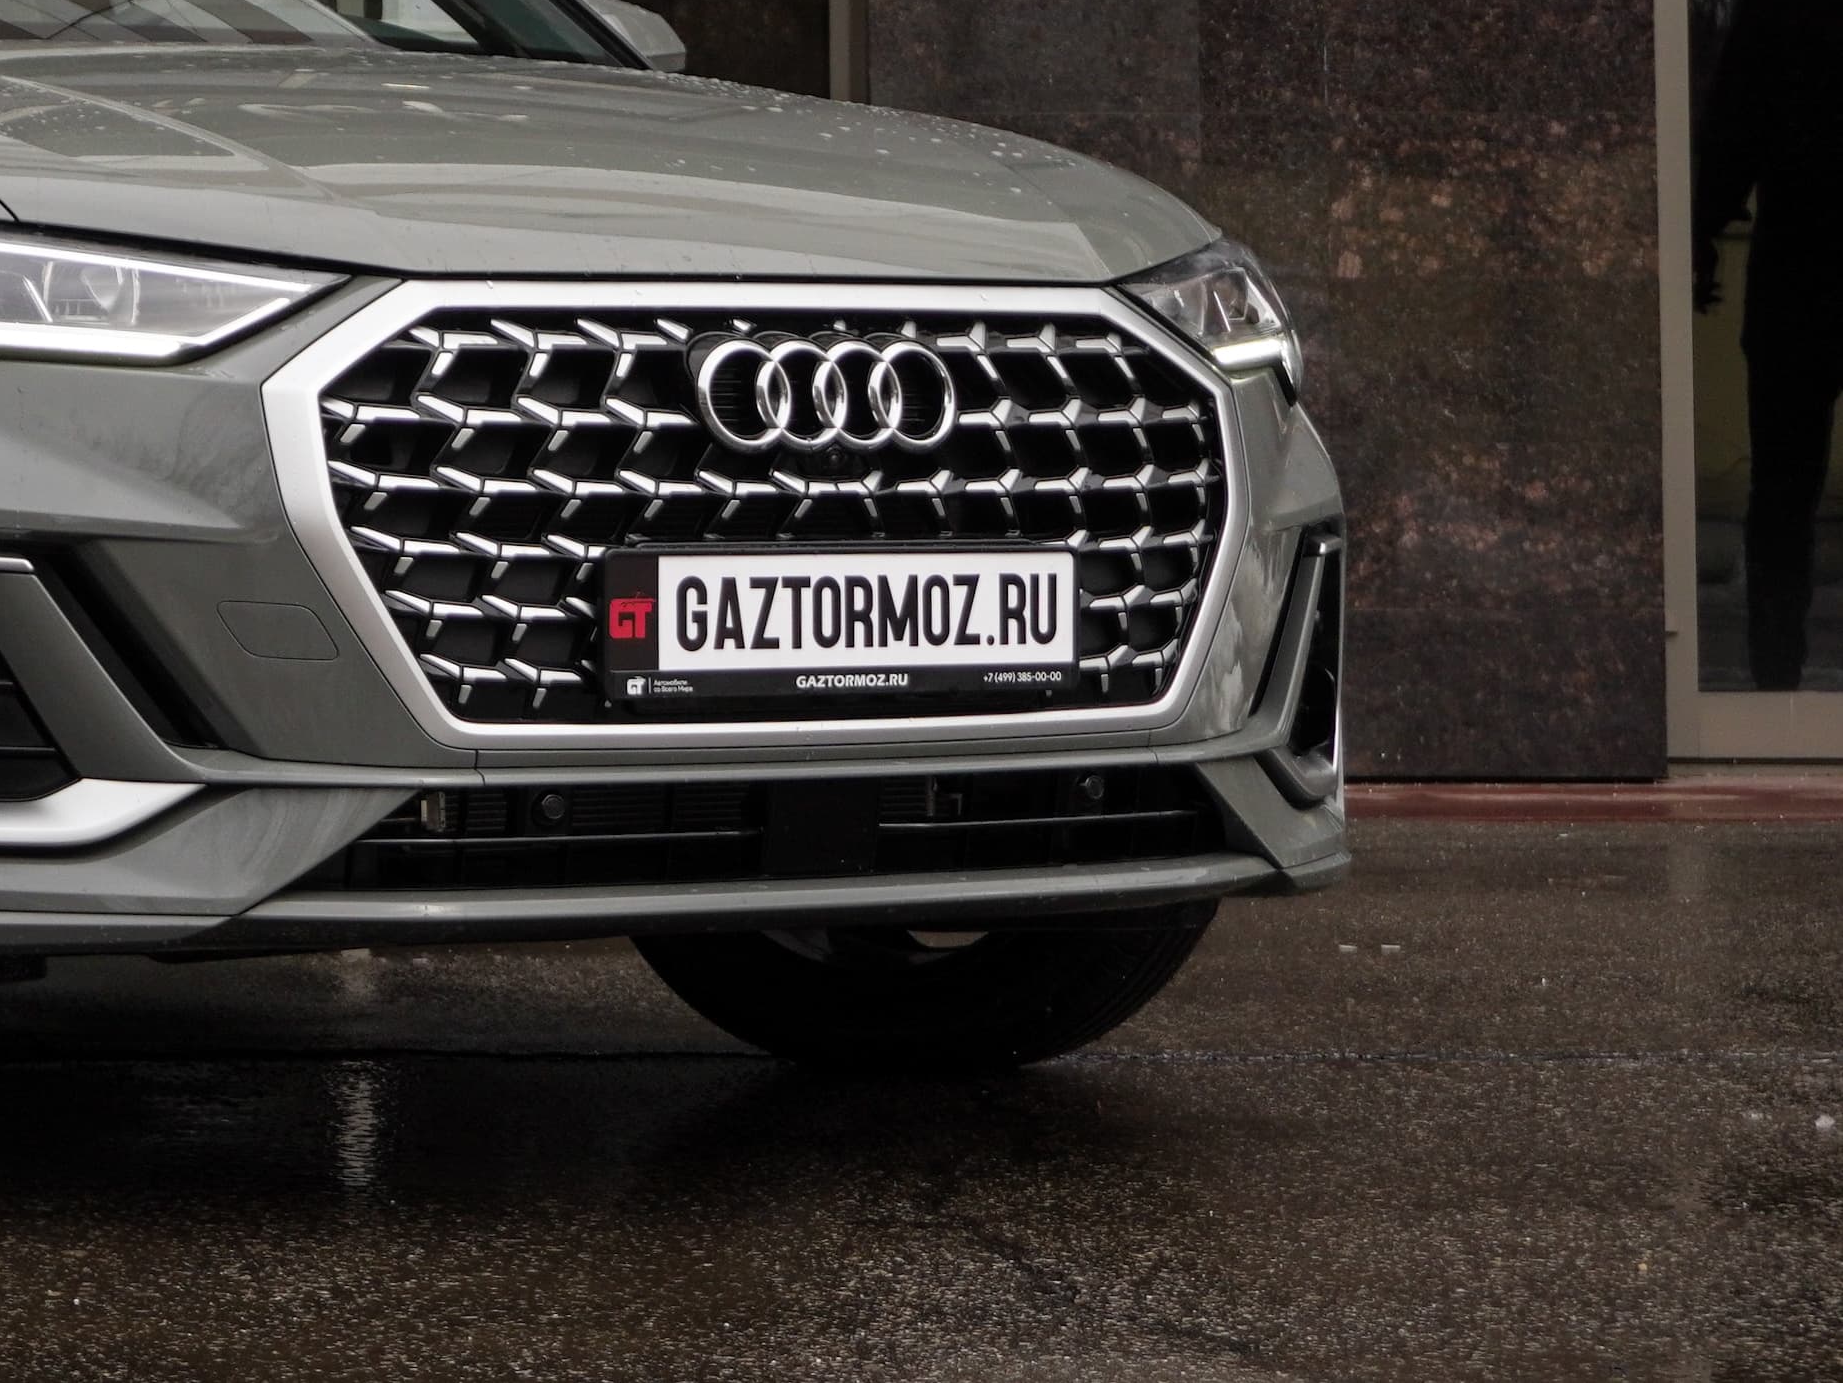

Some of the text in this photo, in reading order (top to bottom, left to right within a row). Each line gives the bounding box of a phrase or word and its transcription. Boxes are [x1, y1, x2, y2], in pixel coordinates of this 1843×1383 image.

[609, 598, 654, 639] GT
[675, 572, 1059, 652] GAZTORMOZ.RU
[796, 673, 909, 688] GAZTORMOZ.RU
[994, 671, 1016, 683] (499)
[1016, 671, 1062, 682] 385-00-00
